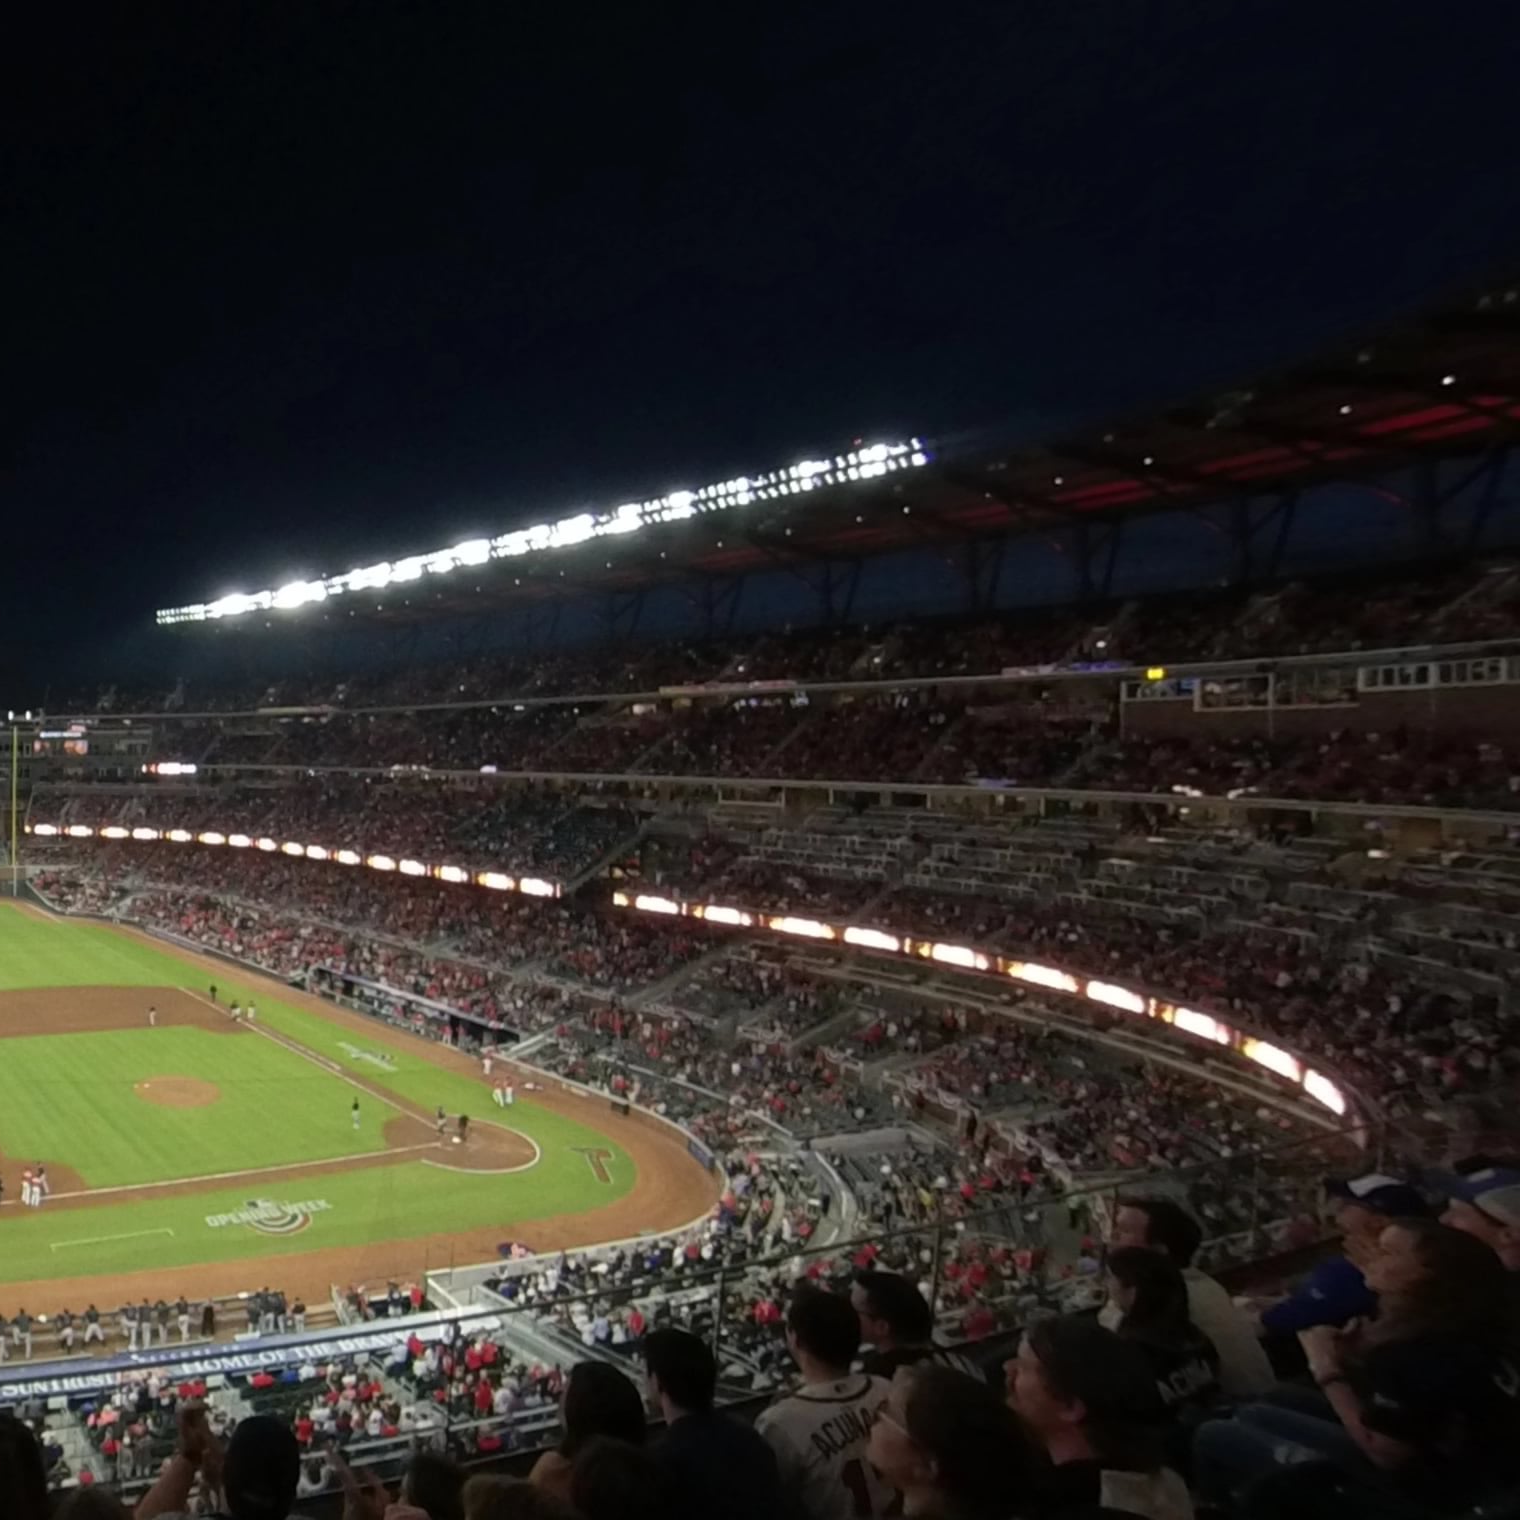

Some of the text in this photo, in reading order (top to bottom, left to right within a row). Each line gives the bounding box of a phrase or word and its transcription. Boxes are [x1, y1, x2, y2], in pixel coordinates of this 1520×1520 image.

[205, 1198, 333, 1228] OPENING WEEK
[182, 1350, 255, 1374] HOME
[257, 1346, 287, 1364] OF
[293, 1340, 331, 1358] THE
[1, 1374, 115, 1398] SUNTRUST
